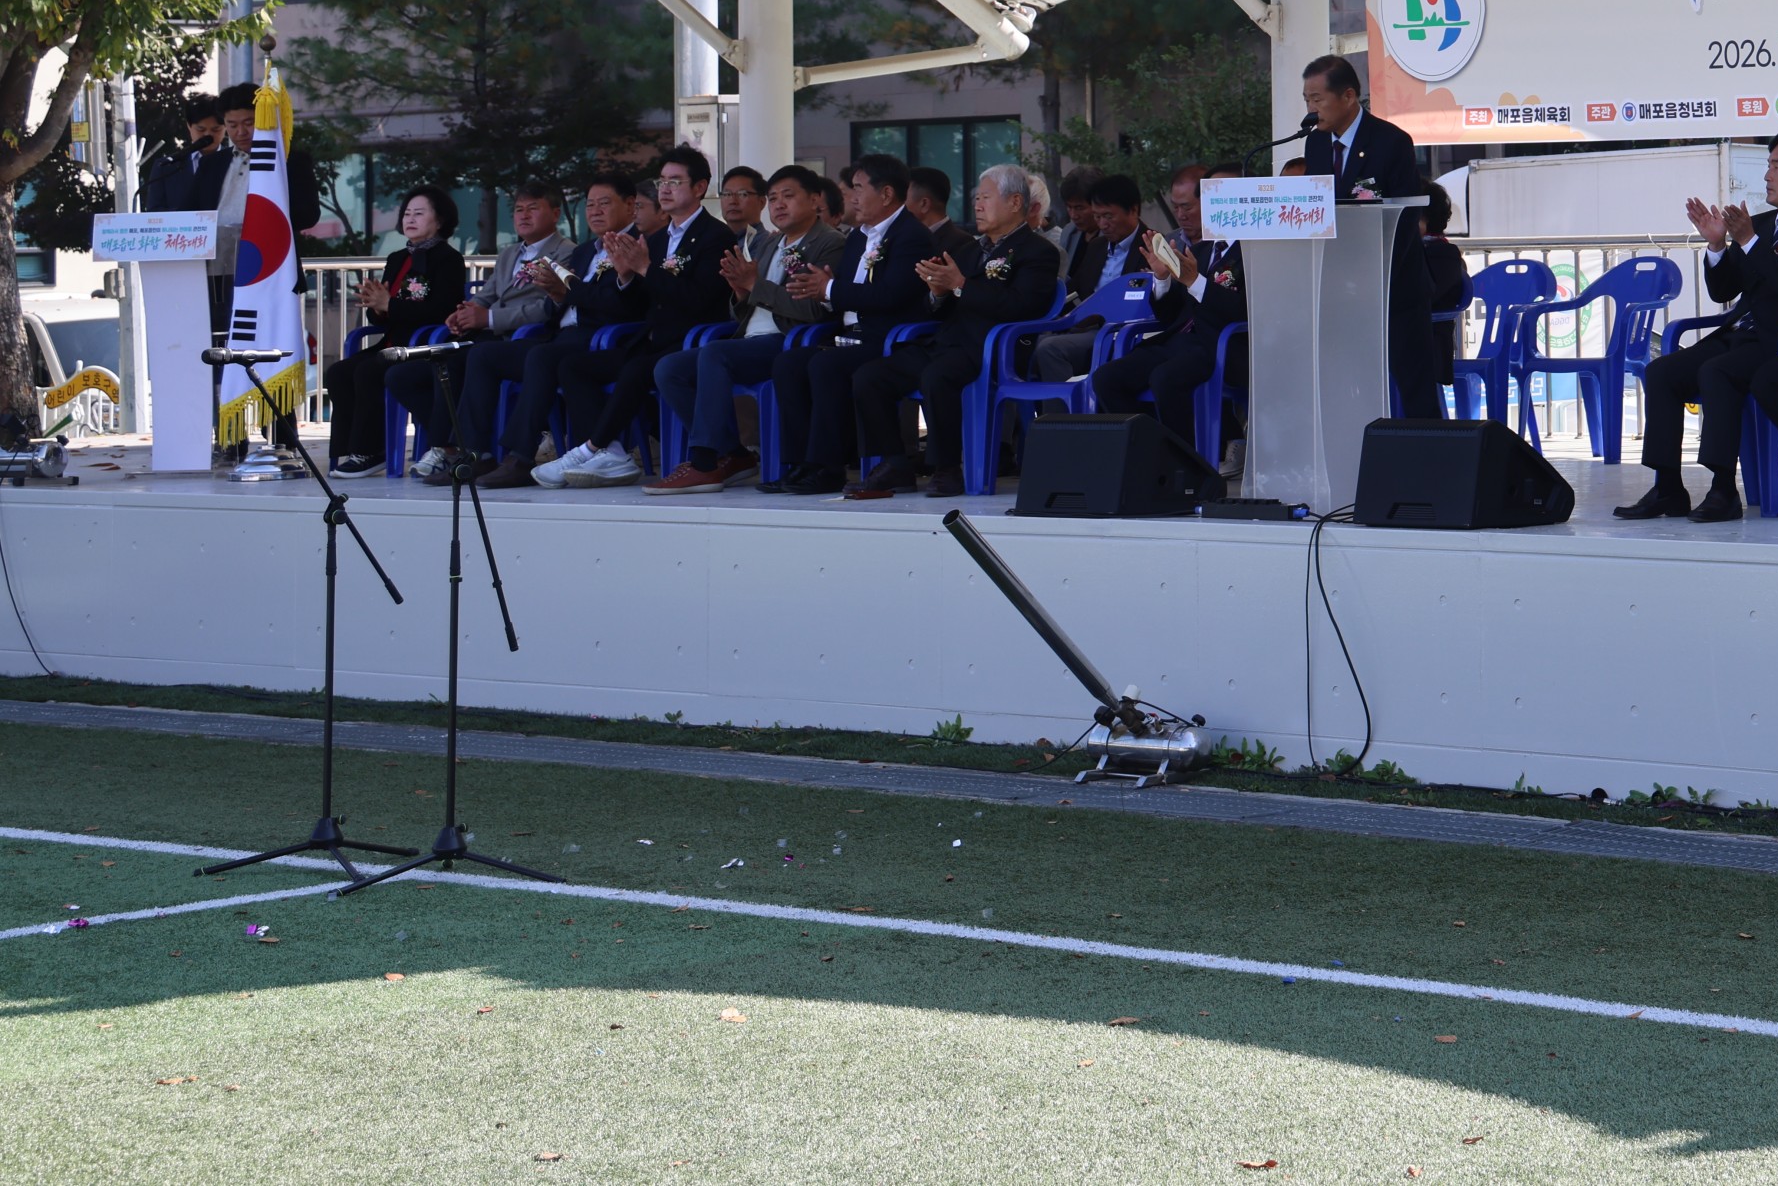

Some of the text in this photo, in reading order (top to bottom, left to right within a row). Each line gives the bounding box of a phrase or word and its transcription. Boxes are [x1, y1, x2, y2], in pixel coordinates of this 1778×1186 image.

[1708, 39, 1777, 70] 2026.
[1468, 110, 1488, 124] 주최
[1497, 107, 1571, 125] 매포읍체육회
[1590, 106, 1611, 120] 주관
[1639, 100, 1717, 120] 매포읍청년회
[1741, 98, 1763, 114] 후원
[1210, 204, 1325, 230] 매포읍민 화합 체육대회
[101, 234, 208, 254] 매포읍민 화합 체육대회
[47, 372, 119, 406] 어린이 보호구역
